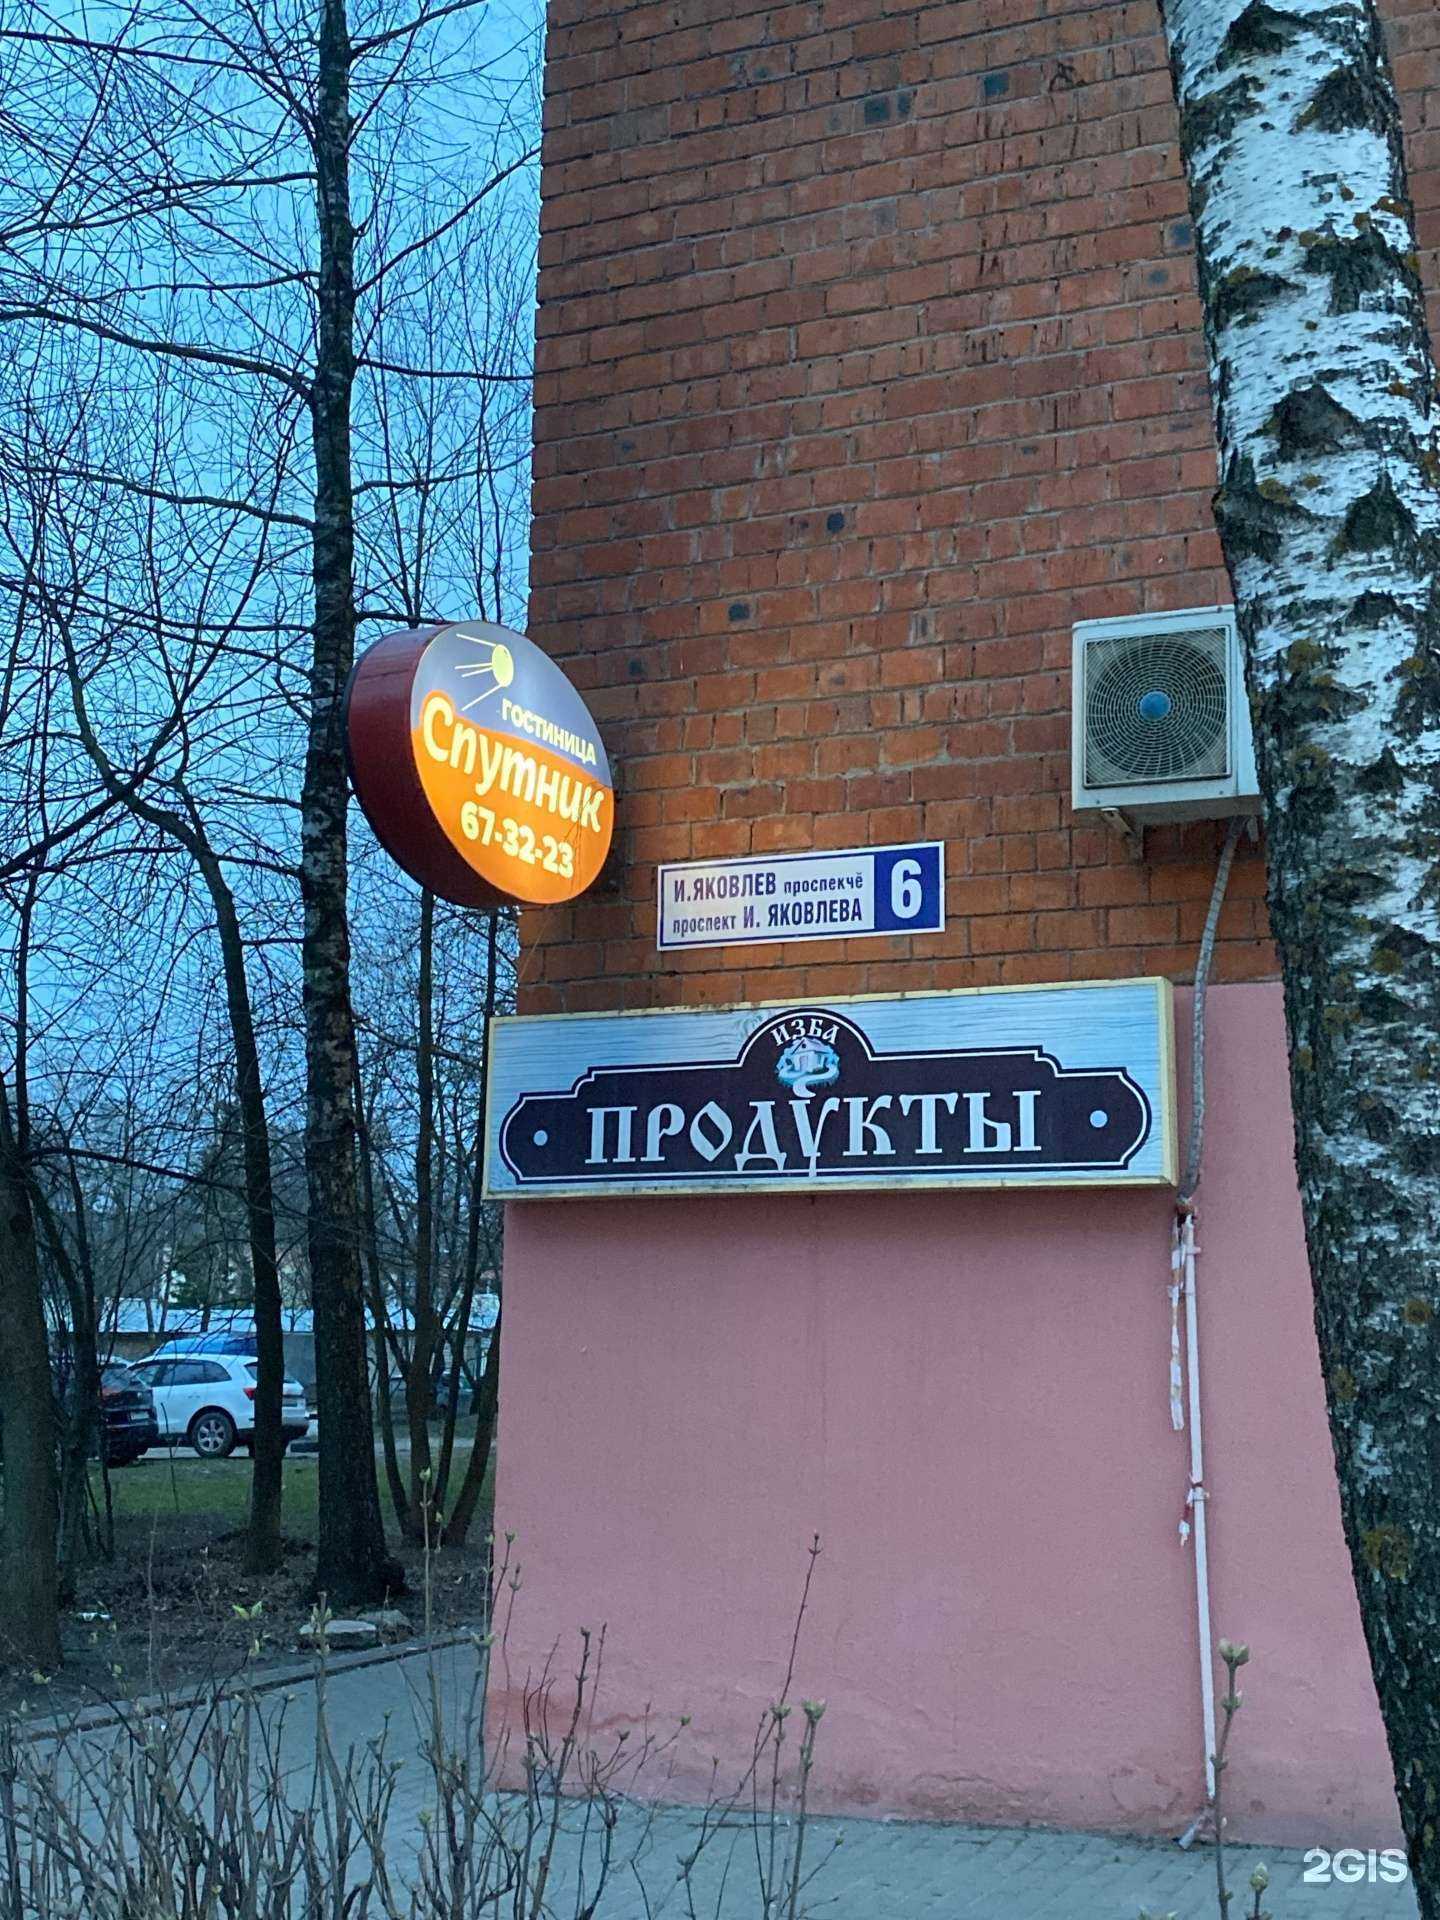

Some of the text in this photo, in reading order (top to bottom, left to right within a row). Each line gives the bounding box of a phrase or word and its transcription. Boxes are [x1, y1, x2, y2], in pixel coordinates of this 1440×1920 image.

[422, 696, 605, 833] Спутник
[502, 697, 597, 766] ГОСТИНИЦА
[460, 801, 574, 880] 67-32-23
[672, 914, 737, 938] проспект
[767, 898, 863, 928] ЯКОВЛЕВА
[890, 858, 923, 920] 6
[770, 1018, 840, 1047] ИЗБА
[584, 1089, 1042, 1177] ПРОДУКТЫ
